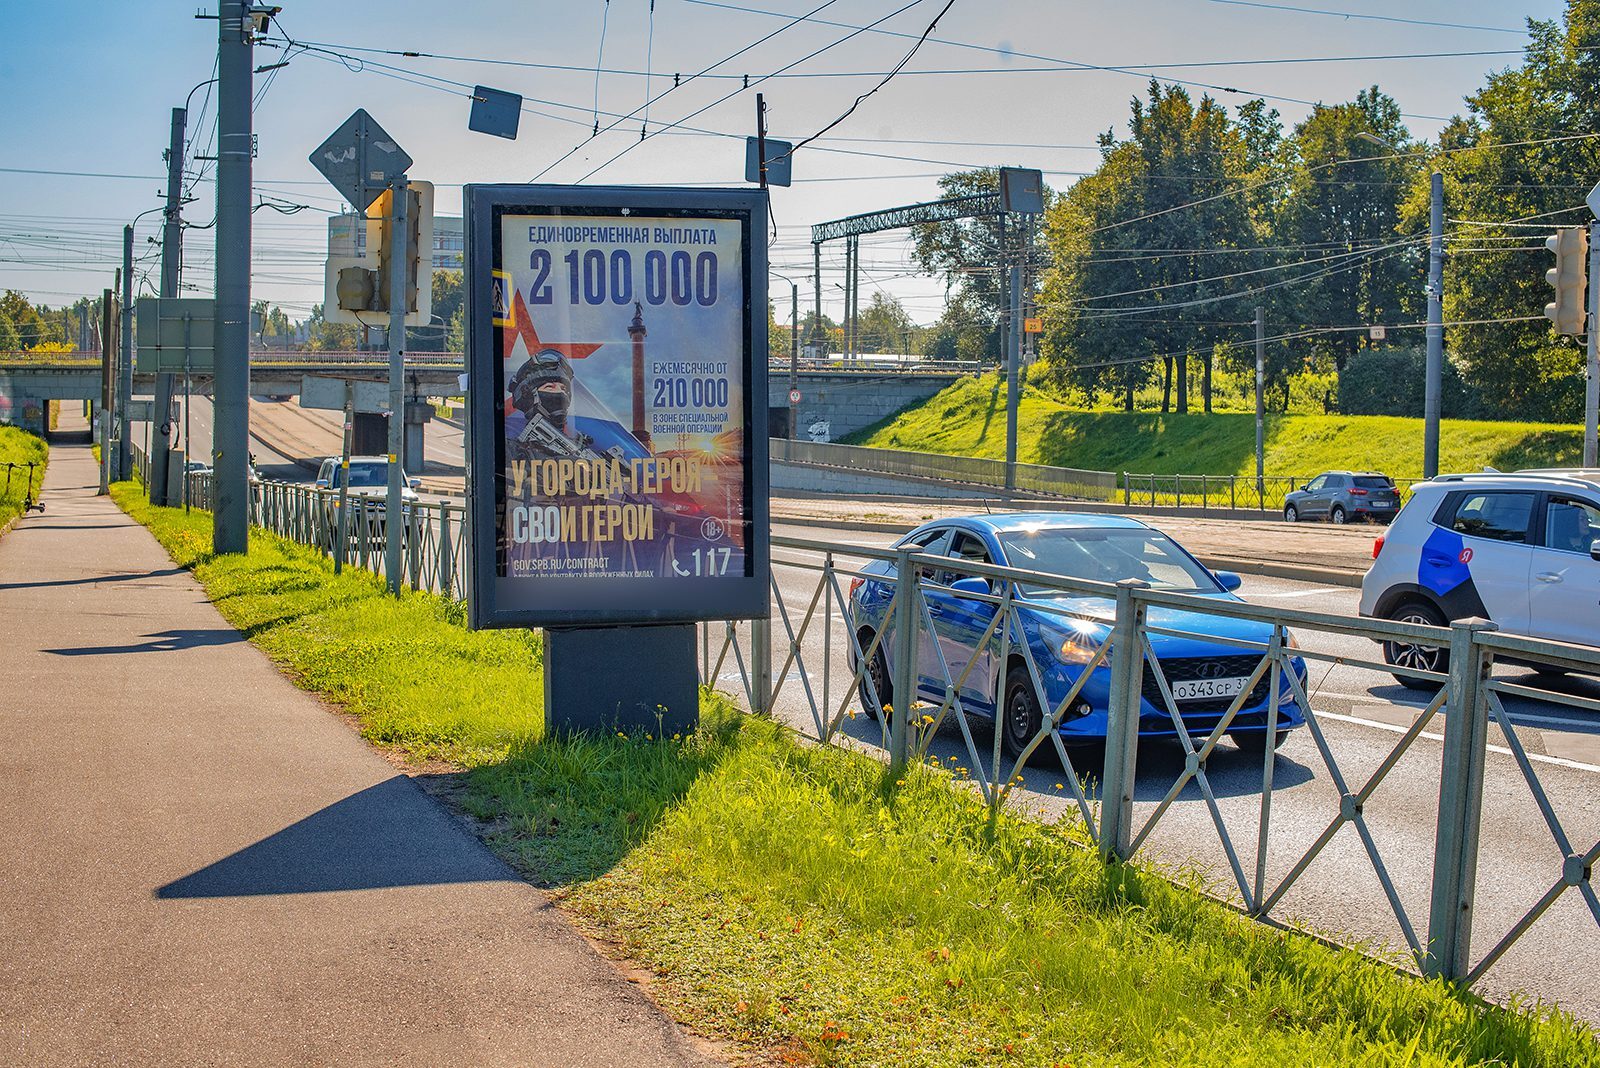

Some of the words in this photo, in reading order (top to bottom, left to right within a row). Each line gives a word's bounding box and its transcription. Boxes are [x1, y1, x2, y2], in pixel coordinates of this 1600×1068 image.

[528, 226, 649, 244] ЕДИНОВРЕМЕННАЯ
[654, 227, 717, 245] ВЫПЛАТА
[529, 249, 553, 305] 2
[564, 249, 632, 306] 100
[645, 250, 718, 307] 000
[653, 362, 715, 374] ЕЖЕМЕСЯЧНО
[716, 362, 728, 374] ОТ
[653, 377, 688, 408] 210
[691, 377, 729, 408] 000
[653, 413, 658, 423] В
[659, 413, 678, 423] ЗОНЕ
[678, 411, 729, 424] СПЕЦИАЛЬНОЙ
[653, 423, 686, 434] ВОЕННОЙ
[686, 424, 723, 435] ОПЕРАЦИИ
[511, 459, 526, 497] У
[512, 504, 577, 544] СВОИ
[581, 503, 654, 542] ГЕРОИ
[705, 521, 722, 537] 18+
[514, 557, 610, 571] GOV.SPB.RU/CONTRACT
[692, 547, 731, 577] 117
